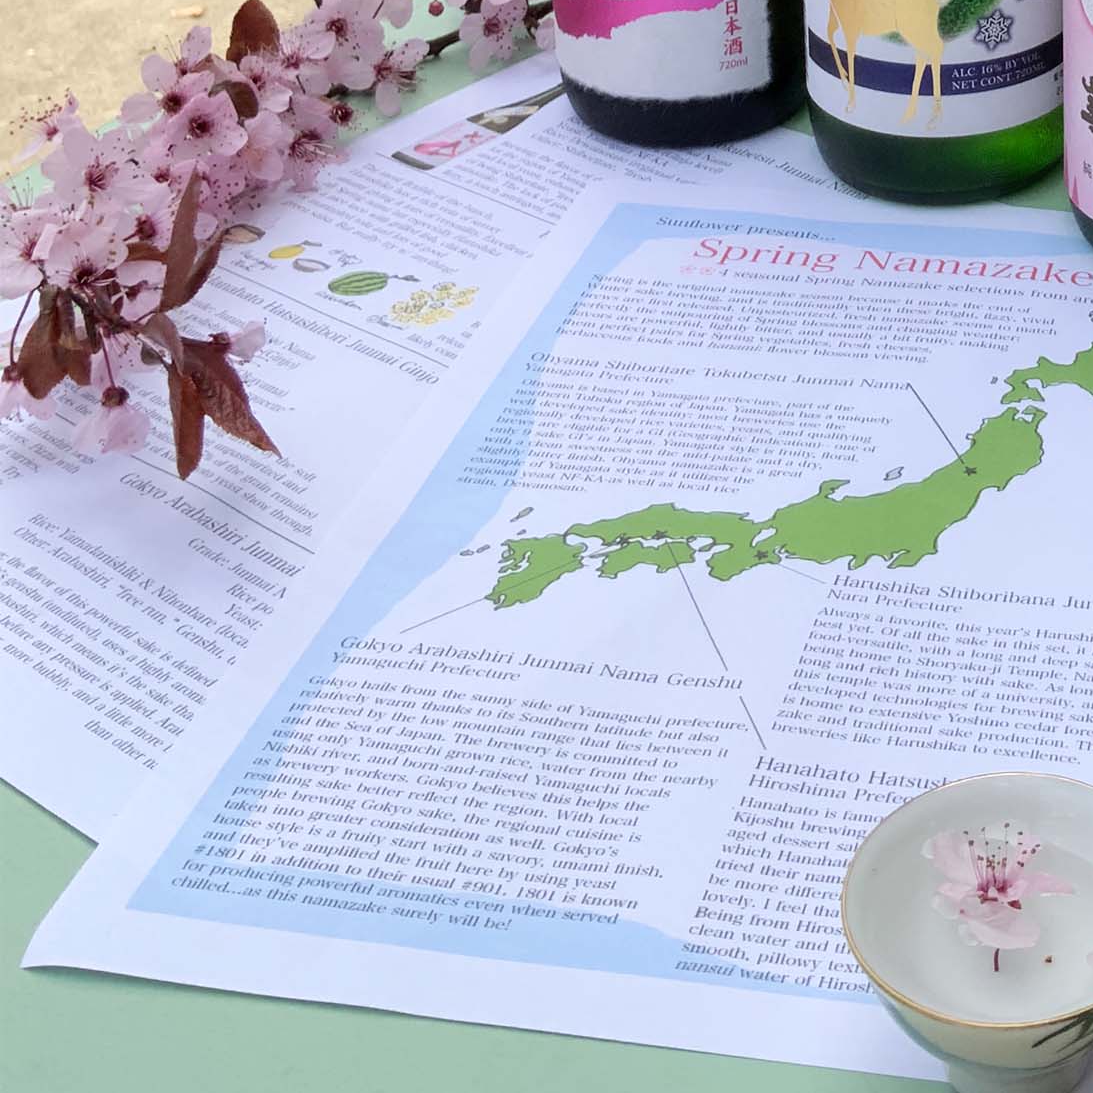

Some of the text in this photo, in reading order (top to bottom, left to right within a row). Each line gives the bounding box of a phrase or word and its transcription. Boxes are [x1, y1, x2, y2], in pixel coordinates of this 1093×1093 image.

[719, 57, 748, 72] 720ml
[1005, 59, 1018, 70] BY
[951, 80, 978, 90] NET
[776, 160, 827, 186] Junmai
[656, 217, 743, 232] Sunflower
[692, 238, 840, 273] Spring
[854, 250, 1093, 287] Namazake
[719, 269, 729, 277] 4
[734, 271, 801, 282] seasonal
[804, 275, 855, 287] Spring
[860, 277, 943, 290] Namazake
[947, 284, 1024, 297] selections
[1030, 290, 1068, 301] from
[262, 301, 348, 344] Hatsushibori
[345, 339, 399, 366] Junmai
[399, 361, 440, 384] Ginjo
[526, 362, 674, 384] Yamagata Prefecture
[531, 352, 909, 391] Ohyama Shiboritate Tokubetsu Junmai Nama
[119, 473, 302, 577] Gokyo Arabashiri Junmai
[28, 513, 217, 627] Rice: Yamadanishiki & Nihonbare
[188, 538, 276, 593] Grade: Junmai
[826, 588, 963, 613] Nara Prefecture
[833, 574, 930, 596] Harushika
[937, 586, 1055, 607] Shiboribana
[817, 607, 871, 622] Always
[875, 615, 884, 623] a
[889, 615, 948, 631] favorite,
[955, 622, 982, 633] this
[986, 626, 1031, 637] year's
[332, 651, 521, 681] Yamaguchi Prefecture
[340, 636, 743, 689] Gokyo Arabashiri Junmai Nama Genshu
[771, 721, 1081, 765] breweries like Harushika to excellence.
[755, 756, 860, 783] Hanahato
[748, 774, 847, 799] Hiroshima
[231, 786, 623, 841] people brewing Gokyo sake, the regional cuisine
[181, 859, 619, 925] for producing powerful aromatics even when served
[266, 888, 298, 901] this
[301, 895, 387, 914] namazake
[390, 907, 444, 925] surely
[448, 914, 480, 927] will
[483, 917, 512, 931] be!
[674, 961, 815, 987] nansui water of
